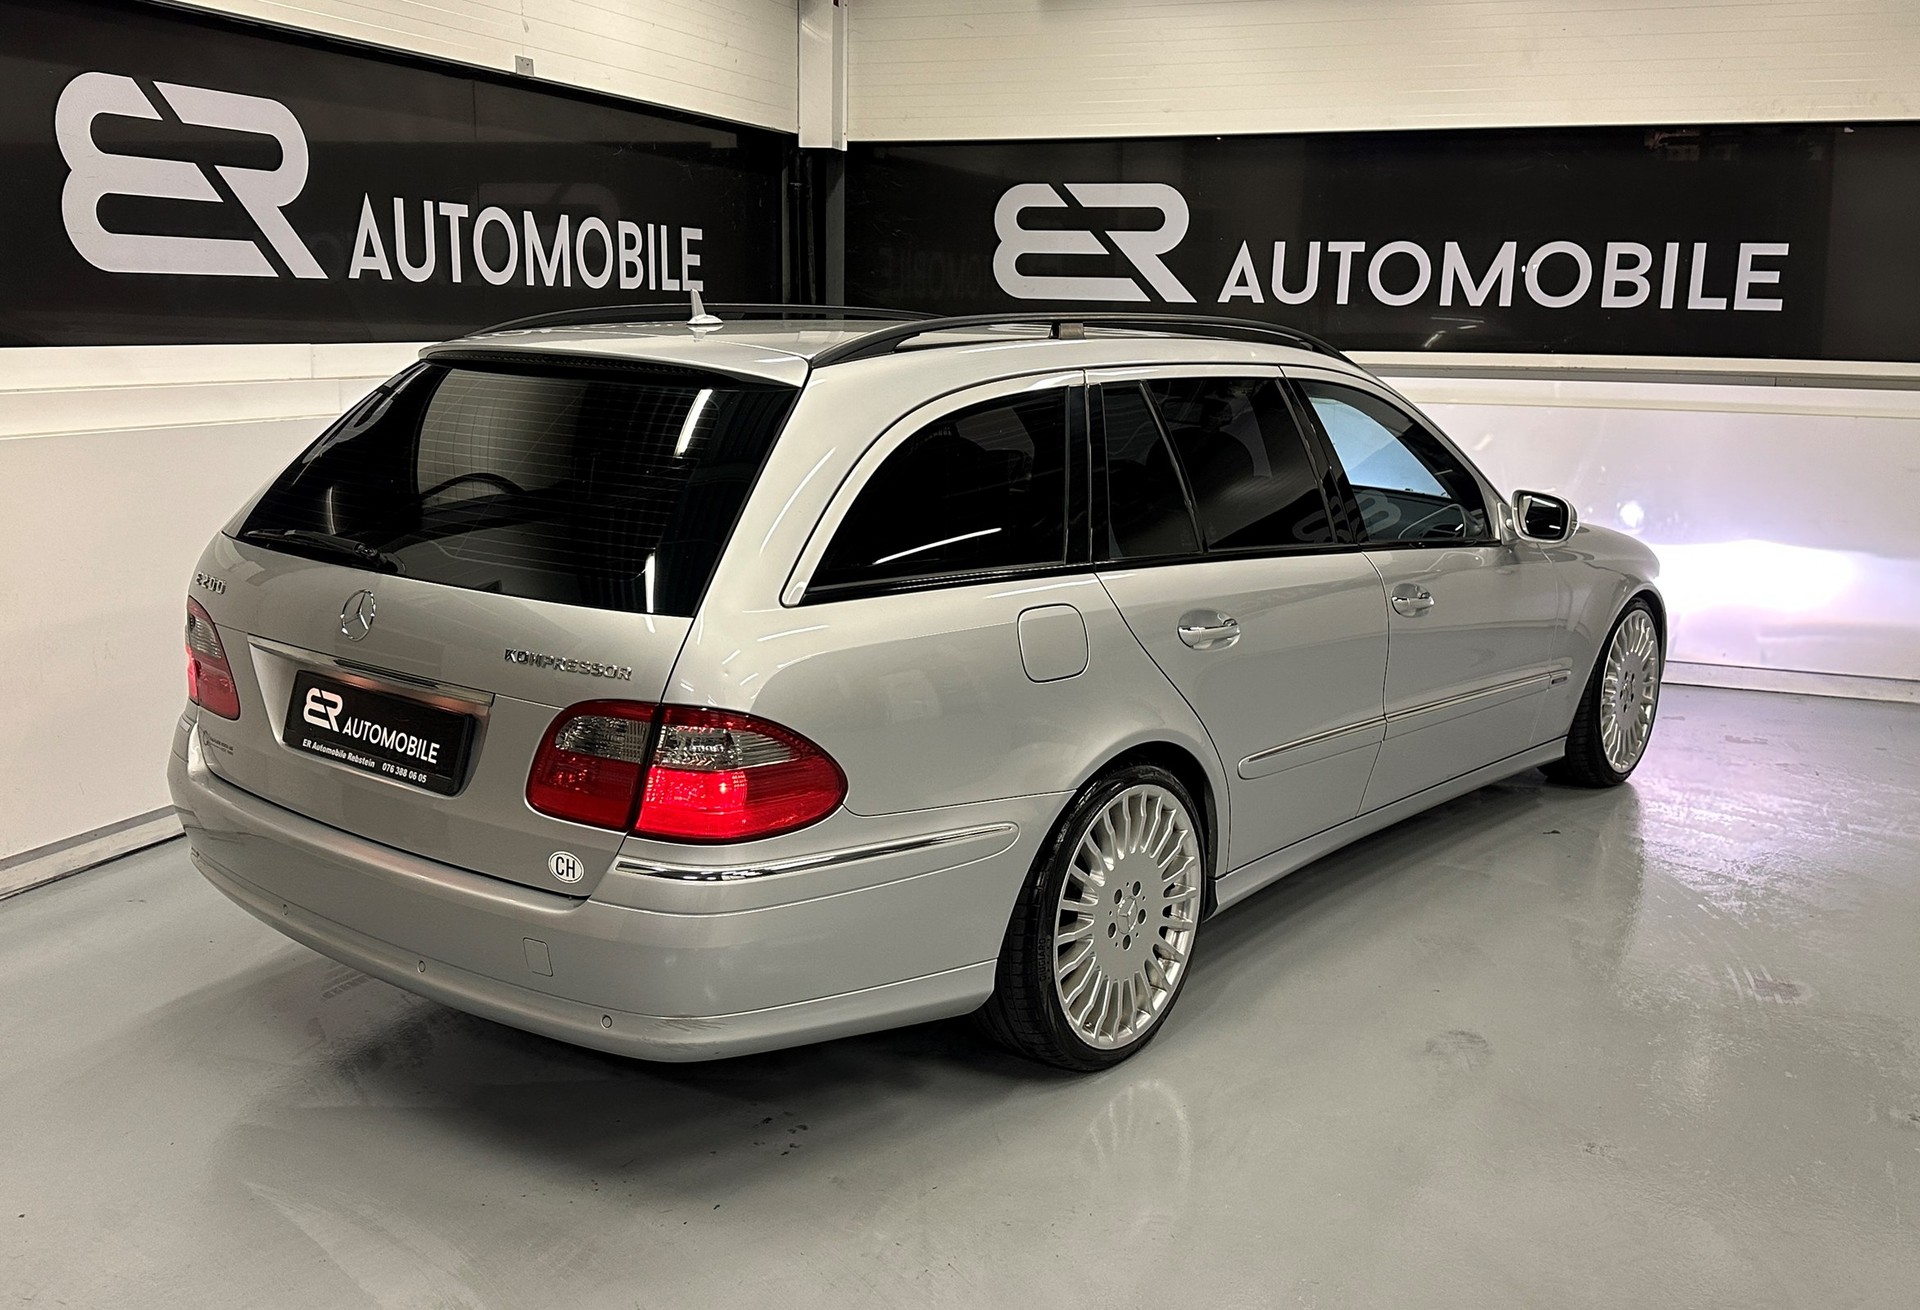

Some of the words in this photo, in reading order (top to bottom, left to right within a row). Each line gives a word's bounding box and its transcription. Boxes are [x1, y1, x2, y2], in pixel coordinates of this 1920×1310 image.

[348, 193, 704, 292] AUTOMOBILE
[1218, 239, 1790, 312] AUTOMOBILE
[504, 647, 633, 681] KOMPRESSOR
[302, 738, 313, 749] ER
[312, 742, 347, 759] Automobile
[347, 752, 376, 768] Rebstein
[381, 762, 395, 774] 076
[395, 766, 408, 778] 388
[408, 770, 418, 781] 06
[418, 773, 428, 784] 05
[342, 716, 441, 764] AUTOMOBILE
[555, 857, 576, 879] CH
